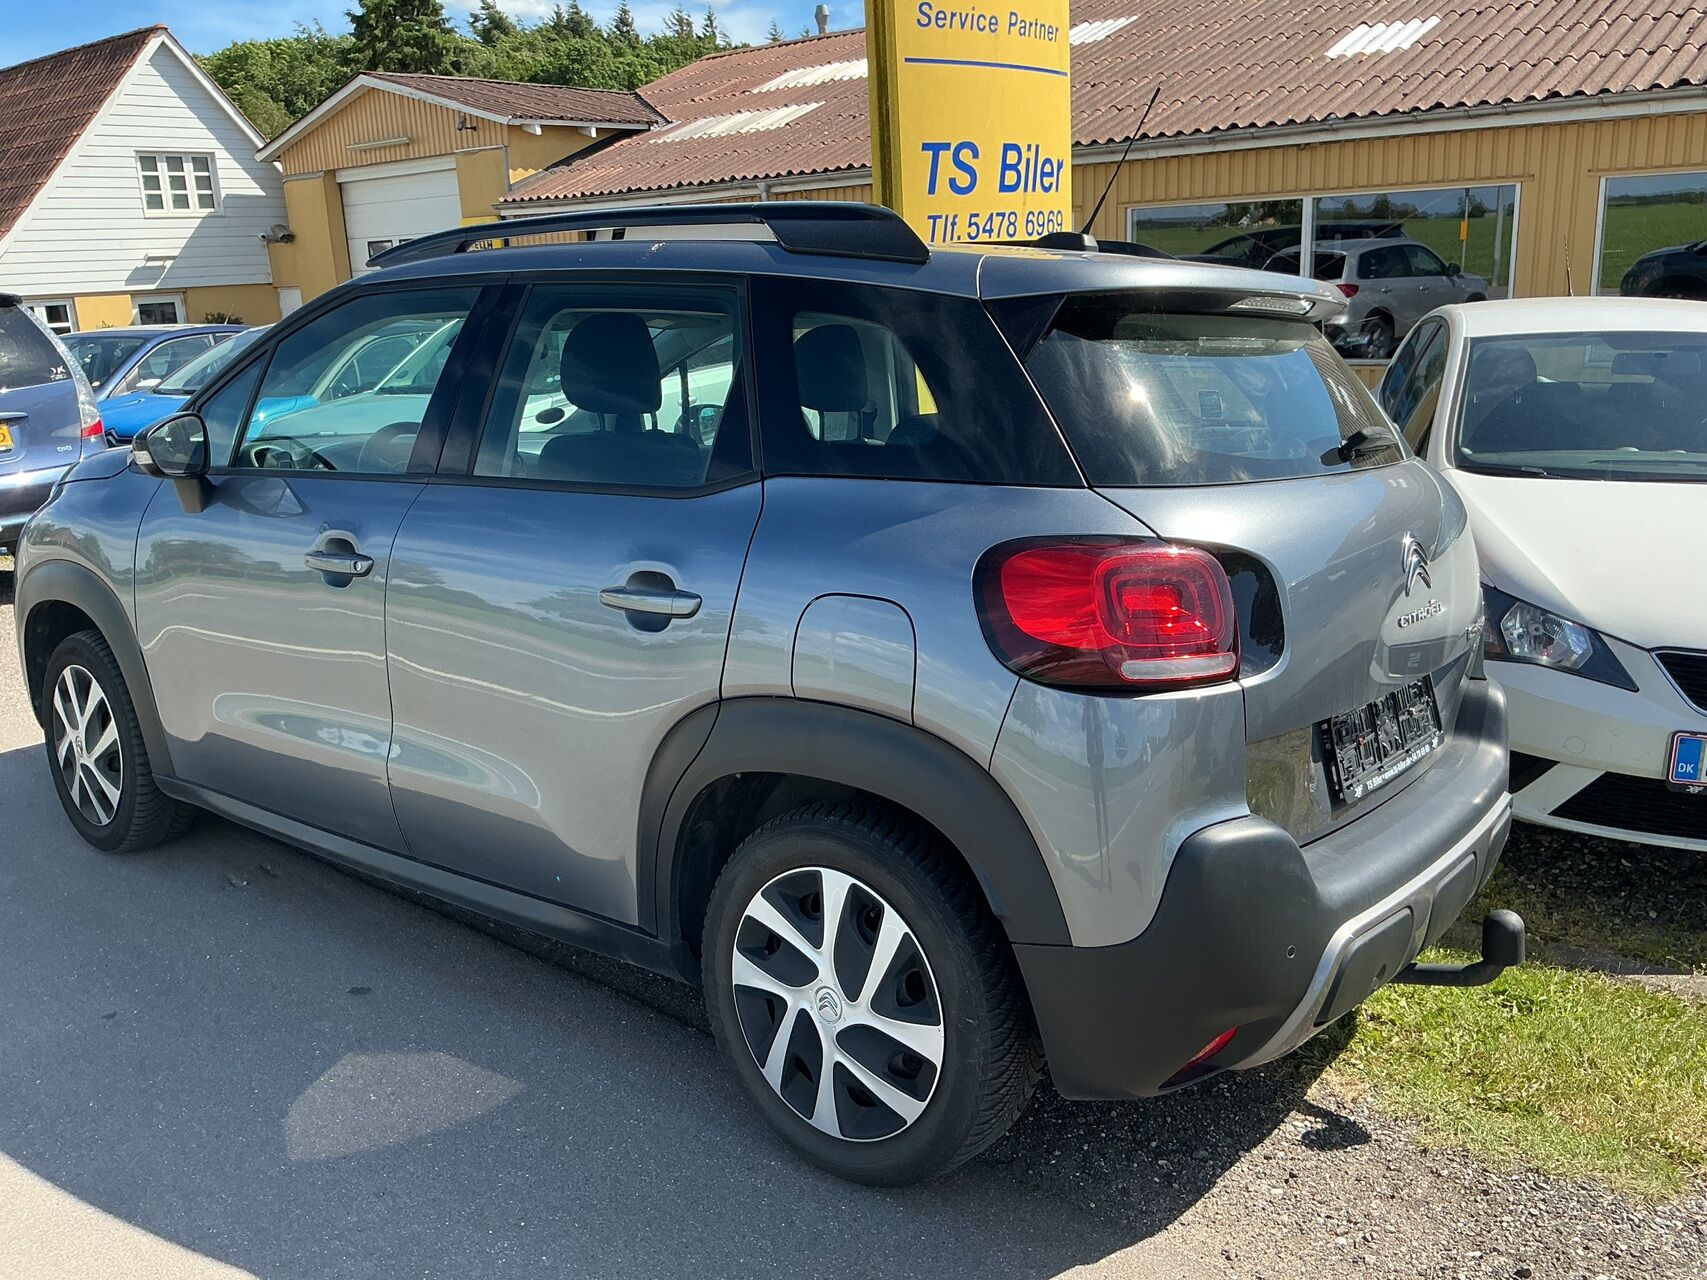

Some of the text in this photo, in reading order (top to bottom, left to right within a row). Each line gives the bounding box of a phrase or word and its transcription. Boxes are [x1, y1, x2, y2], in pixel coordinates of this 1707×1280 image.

[916, 1, 1059, 43] Service Partner
[921, 141, 1064, 196] TS Biler
[927, 210, 1064, 243] Tlf. 5478 6969
[1678, 763, 1694, 774] DK
